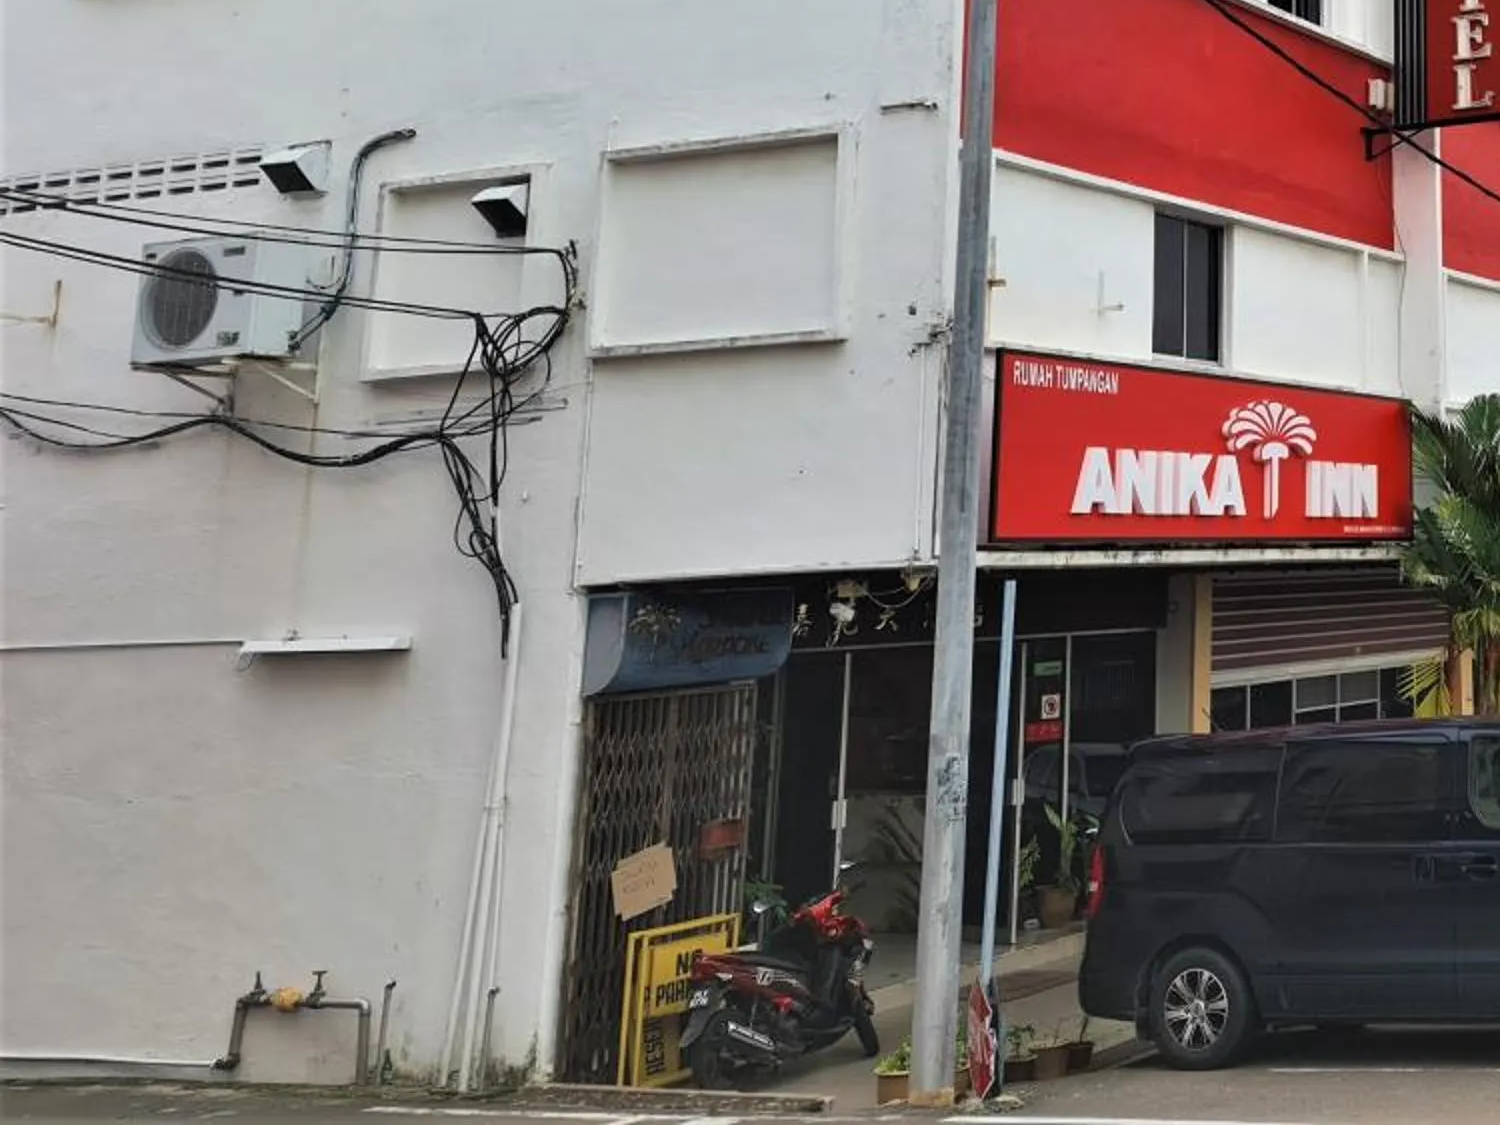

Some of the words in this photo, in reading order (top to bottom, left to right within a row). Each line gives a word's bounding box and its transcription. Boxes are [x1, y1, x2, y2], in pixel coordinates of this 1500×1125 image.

[1013, 360, 1053, 387] RUMAH
[1055, 364, 1120, 394] TUMPANGAN
[1070, 446, 1247, 516] ANIKA
[1305, 460, 1378, 518] INN
